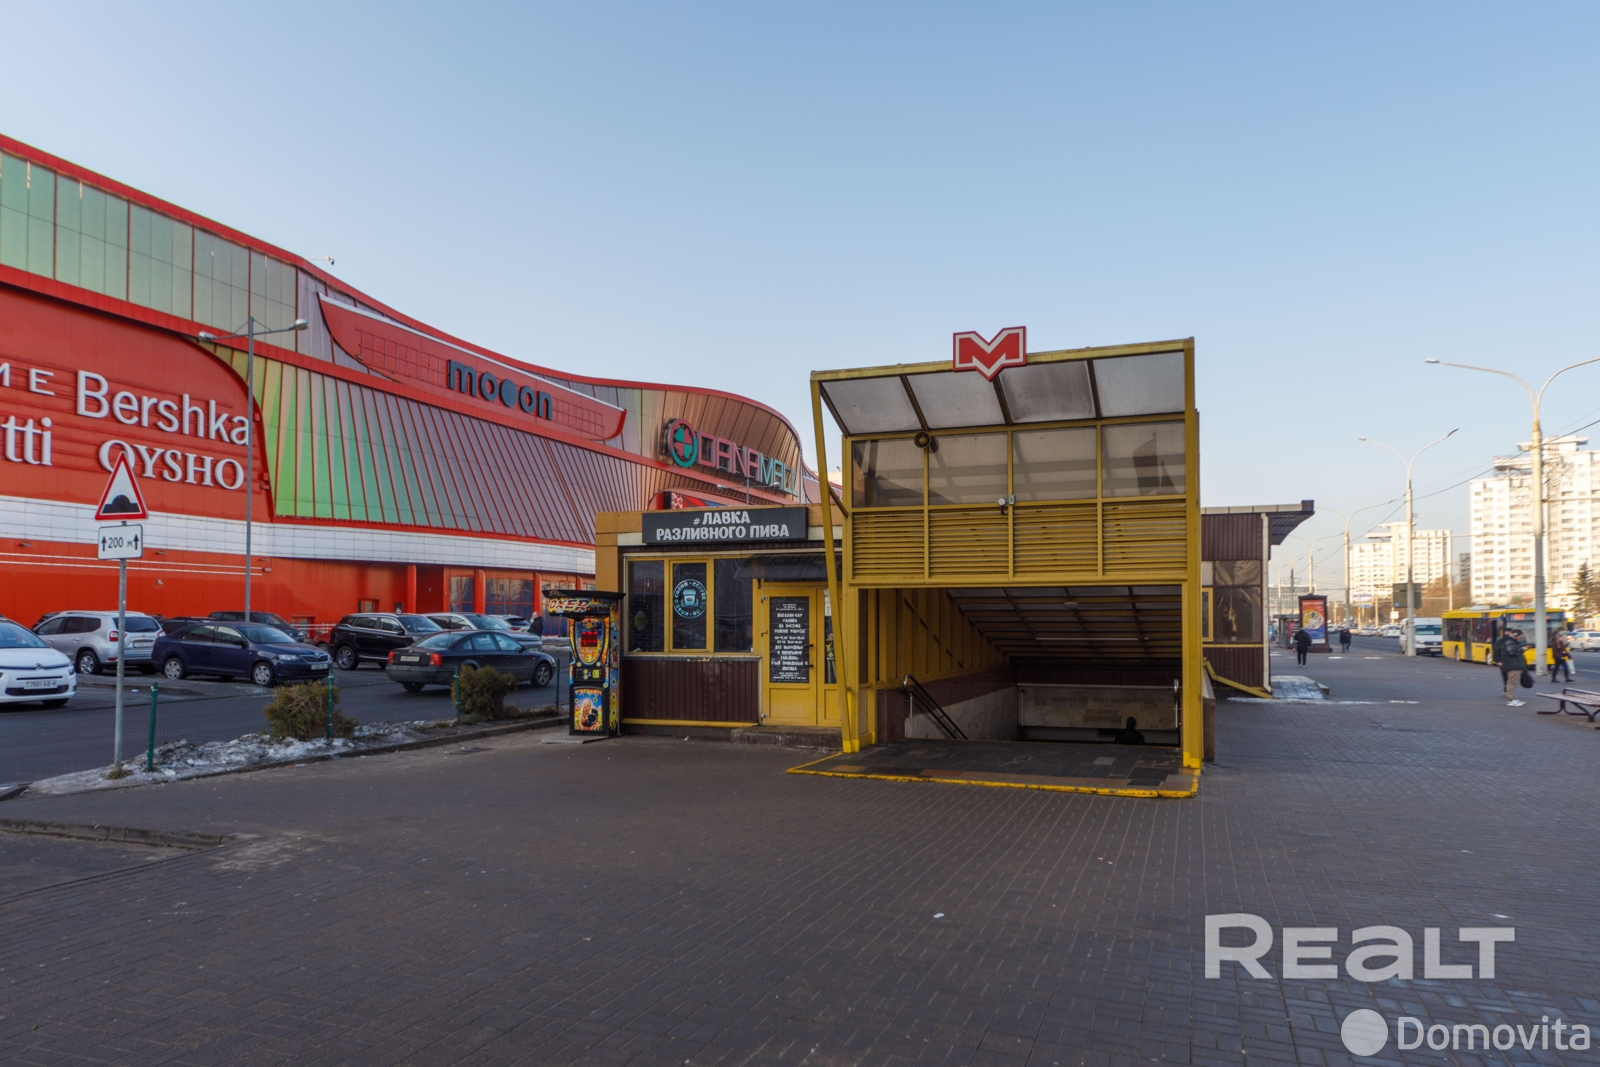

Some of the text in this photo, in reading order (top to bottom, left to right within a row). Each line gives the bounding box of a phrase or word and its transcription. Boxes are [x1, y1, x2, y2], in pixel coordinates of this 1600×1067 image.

[77, 369, 249, 446] Bershka
[99, 439, 244, 490] OYSHO
[108, 537, 124, 548] 200
[656, 524, 789, 541] РАЗЛИВНОГО ПИВА
